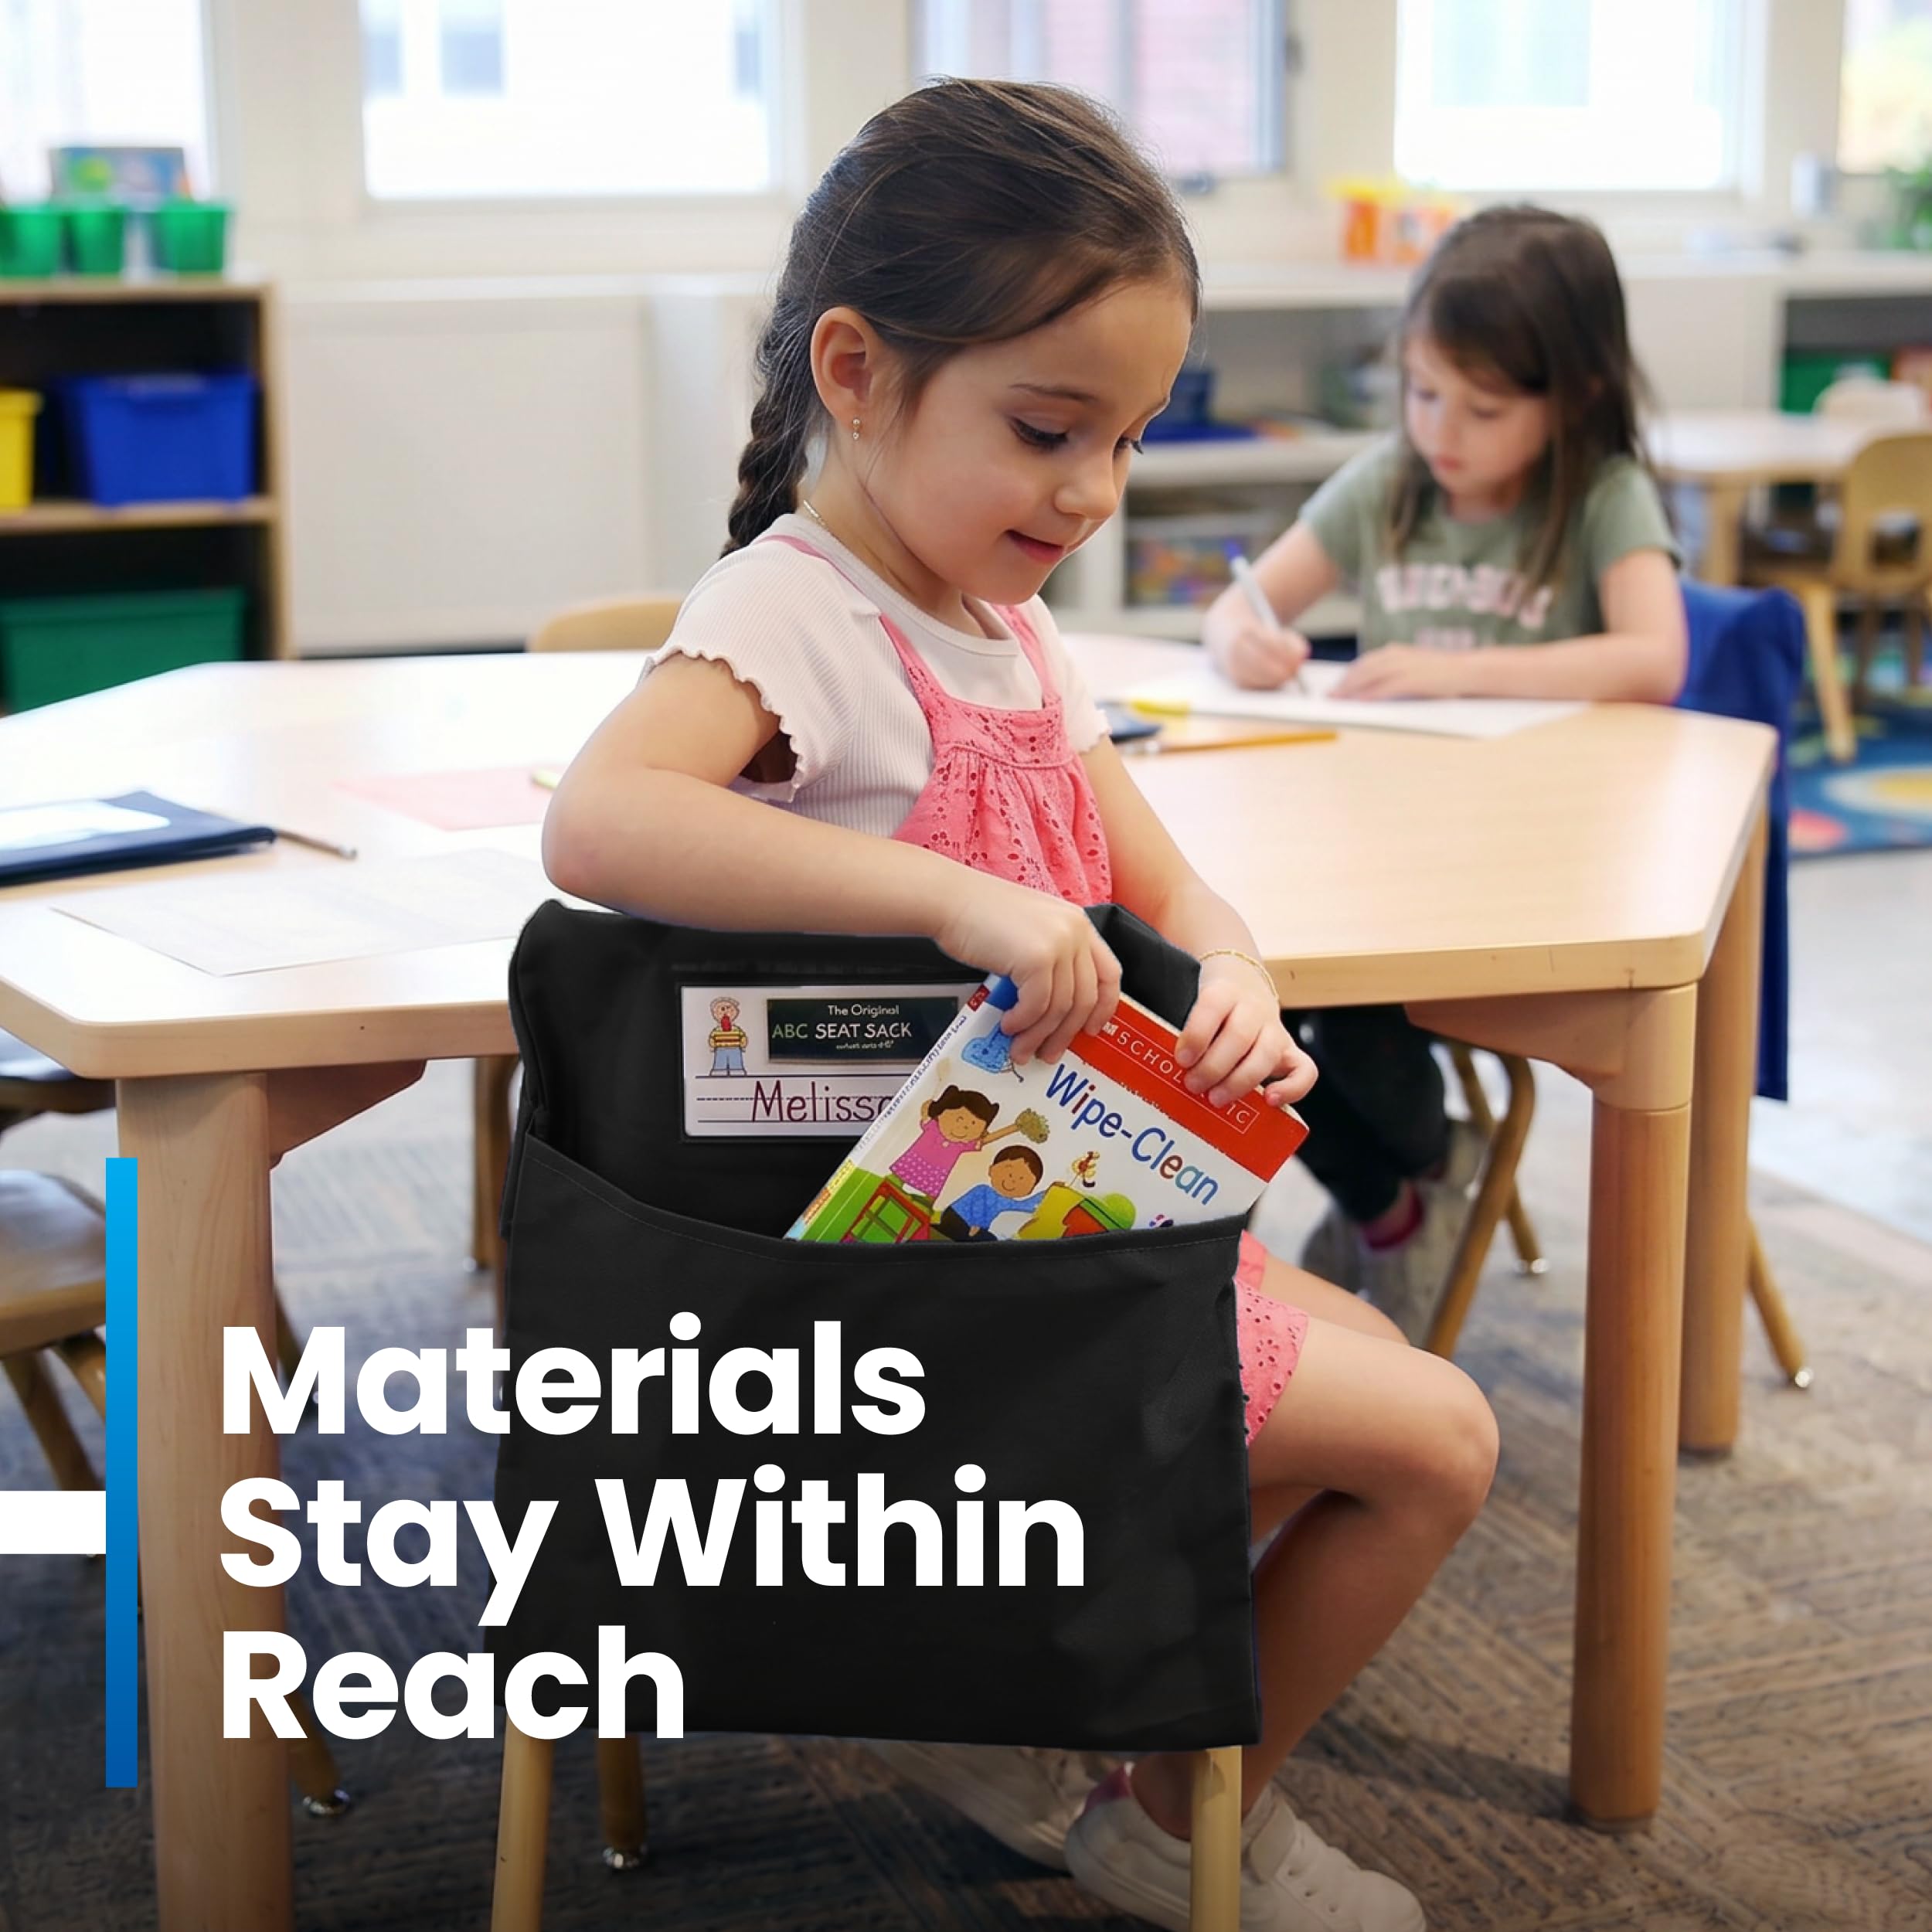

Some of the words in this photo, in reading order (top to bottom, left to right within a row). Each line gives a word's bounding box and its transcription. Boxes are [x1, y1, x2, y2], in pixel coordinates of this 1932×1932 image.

[771, 1023, 808, 1039] ABC
[815, 1023, 860, 1039] SEAT
[865, 1022, 913, 1038] SACK
[828, 1005, 849, 1015] The
[851, 1004, 900, 1019] Original
[1117, 1031, 1250, 1125] SCHOLIC
[1046, 1063, 1219, 1206] Wipe-Clean
